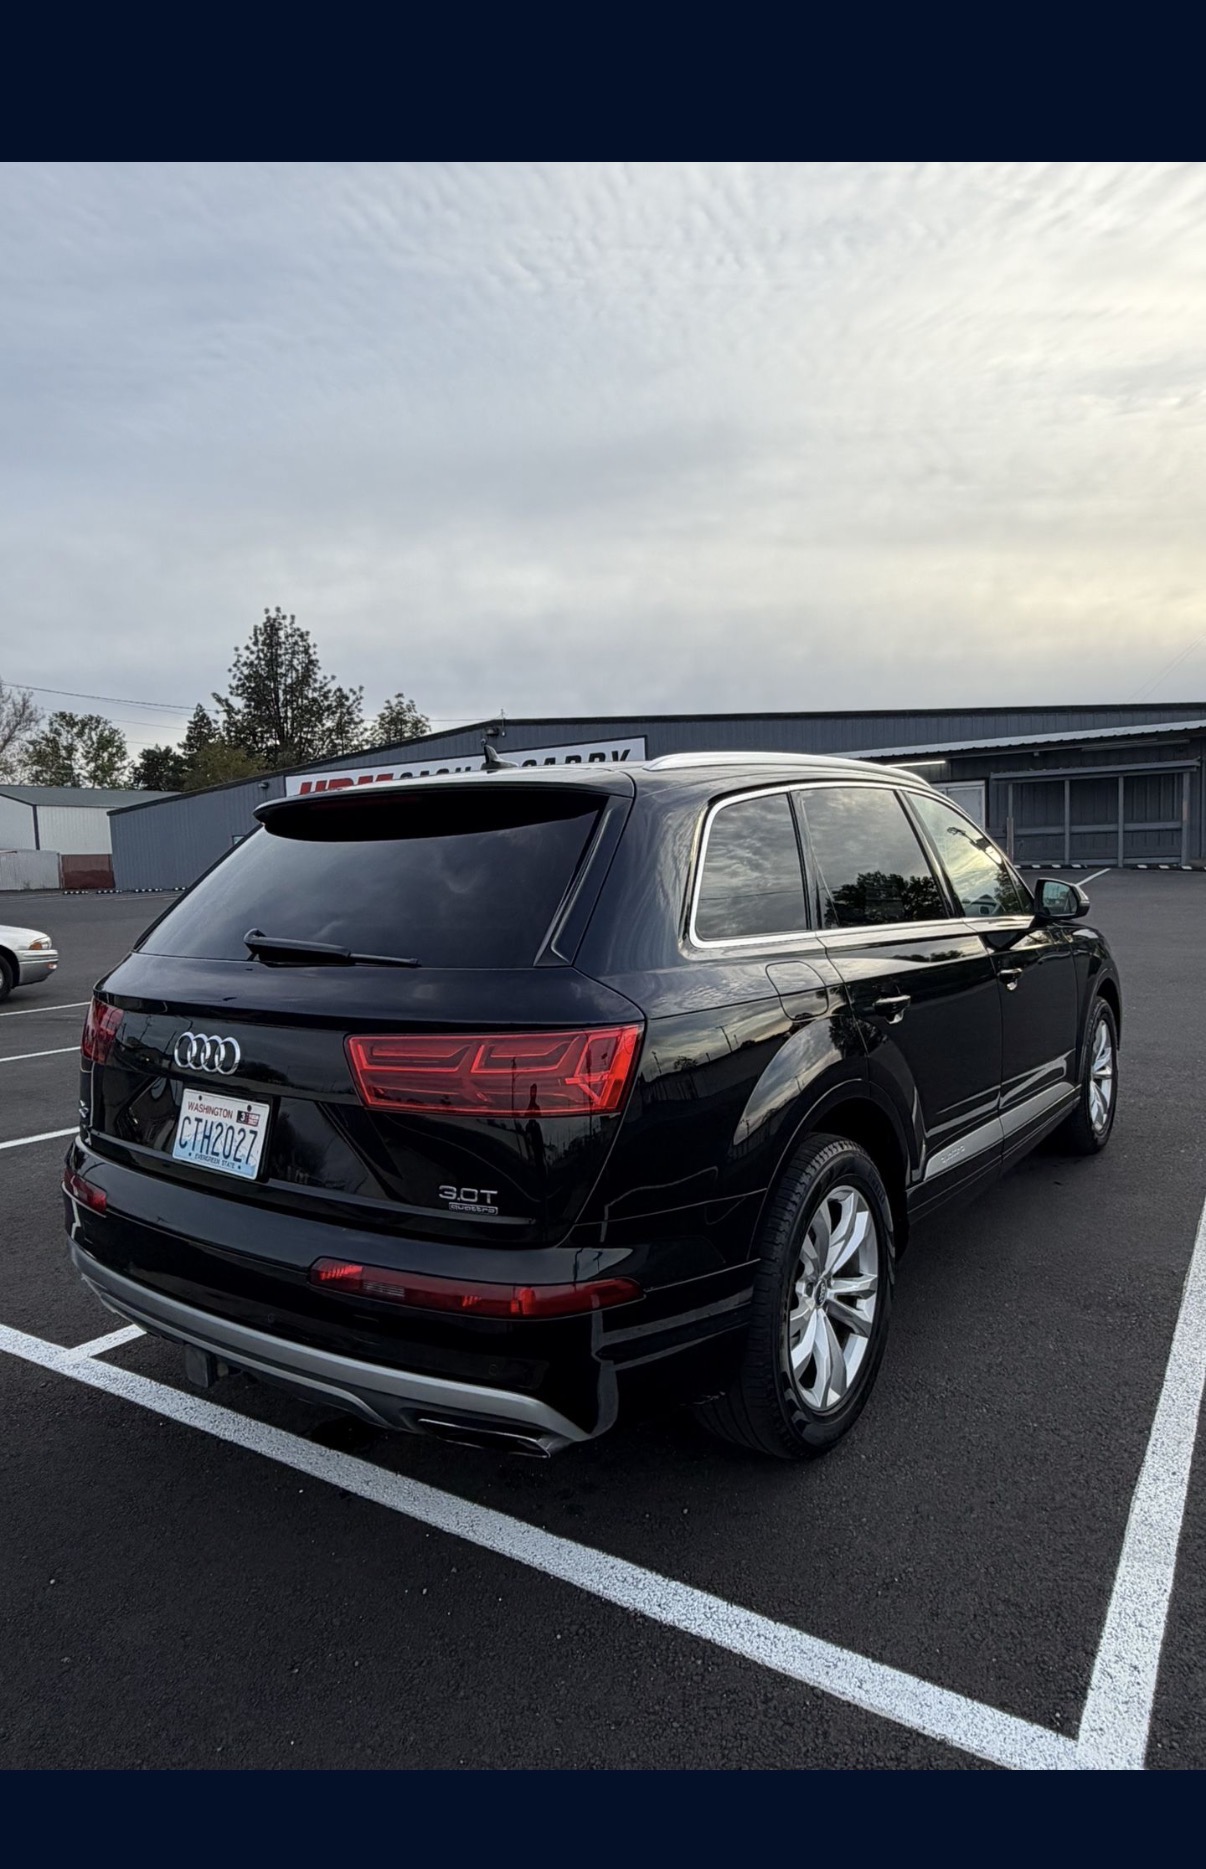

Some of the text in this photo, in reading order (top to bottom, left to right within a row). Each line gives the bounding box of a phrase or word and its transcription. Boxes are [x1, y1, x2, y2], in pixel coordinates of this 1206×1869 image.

[187, 1101, 233, 1119] WASHINGTON
[178, 1116, 258, 1165] CTH2027
[194, 1153, 236, 1169] EVERGREEN STATE
[439, 1185, 498, 1204] 3.0T
[450, 1204, 495, 1214] quattro
